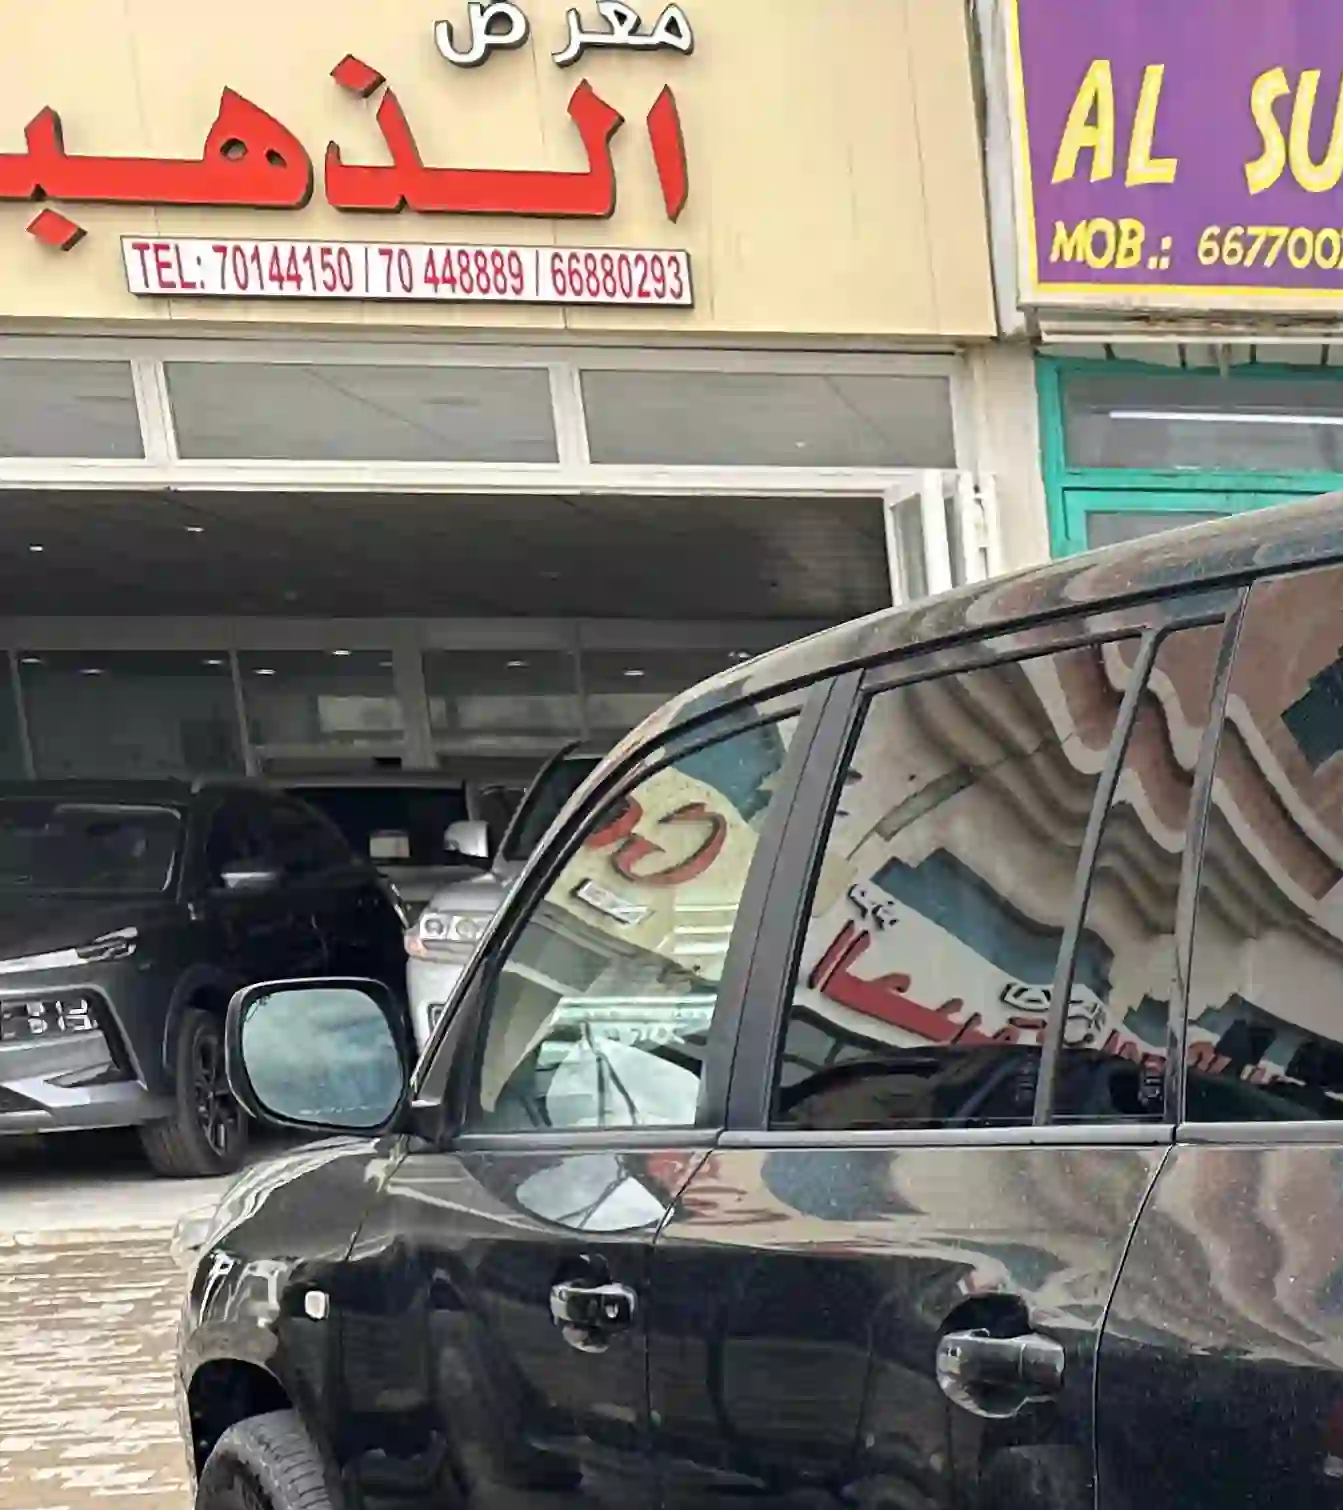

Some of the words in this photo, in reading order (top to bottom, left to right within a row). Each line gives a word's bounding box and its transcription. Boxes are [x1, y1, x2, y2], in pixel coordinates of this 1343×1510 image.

[0, 53, 690, 251] الذهب
[1051, 60, 1178, 188] AL
[132, 243, 205, 289] TEL:
[212, 245, 353, 294] 70144150
[378, 248, 413, 293] 70
[423, 249, 524, 296] 448889
[550, 251, 684, 299] 66880293
[1050, 218, 1172, 270] MOB.:
